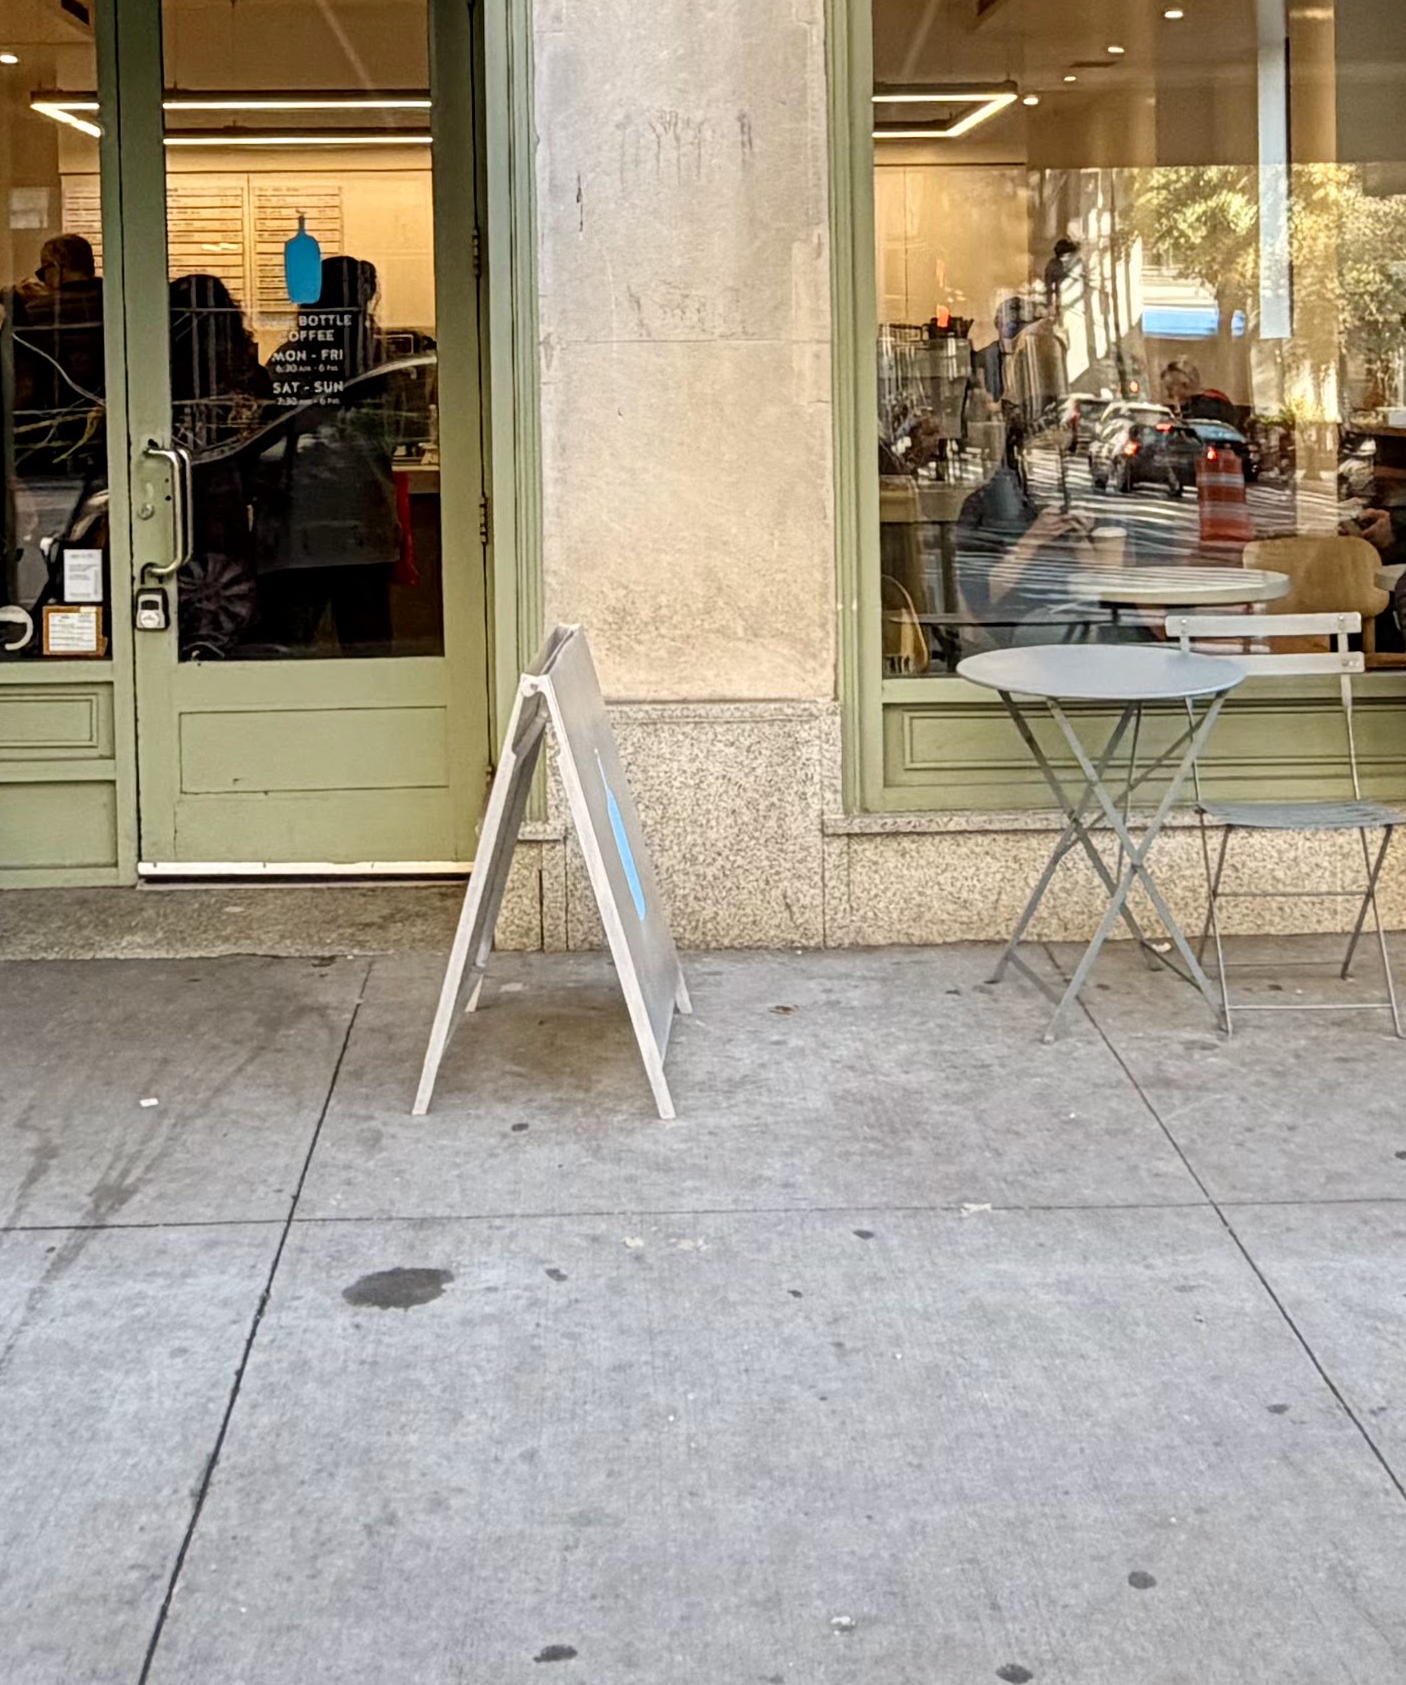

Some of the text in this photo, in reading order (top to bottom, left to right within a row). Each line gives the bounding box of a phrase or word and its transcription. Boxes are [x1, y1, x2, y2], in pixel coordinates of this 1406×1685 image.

[298, 314, 352, 327] BOTTLE
[282, 329, 335, 342] OFFEE
[272, 349, 307, 362] MON
[320, 349, 343, 361] FRI
[273, 381, 301, 394] SAT
[314, 380, 344, 393] SUN
